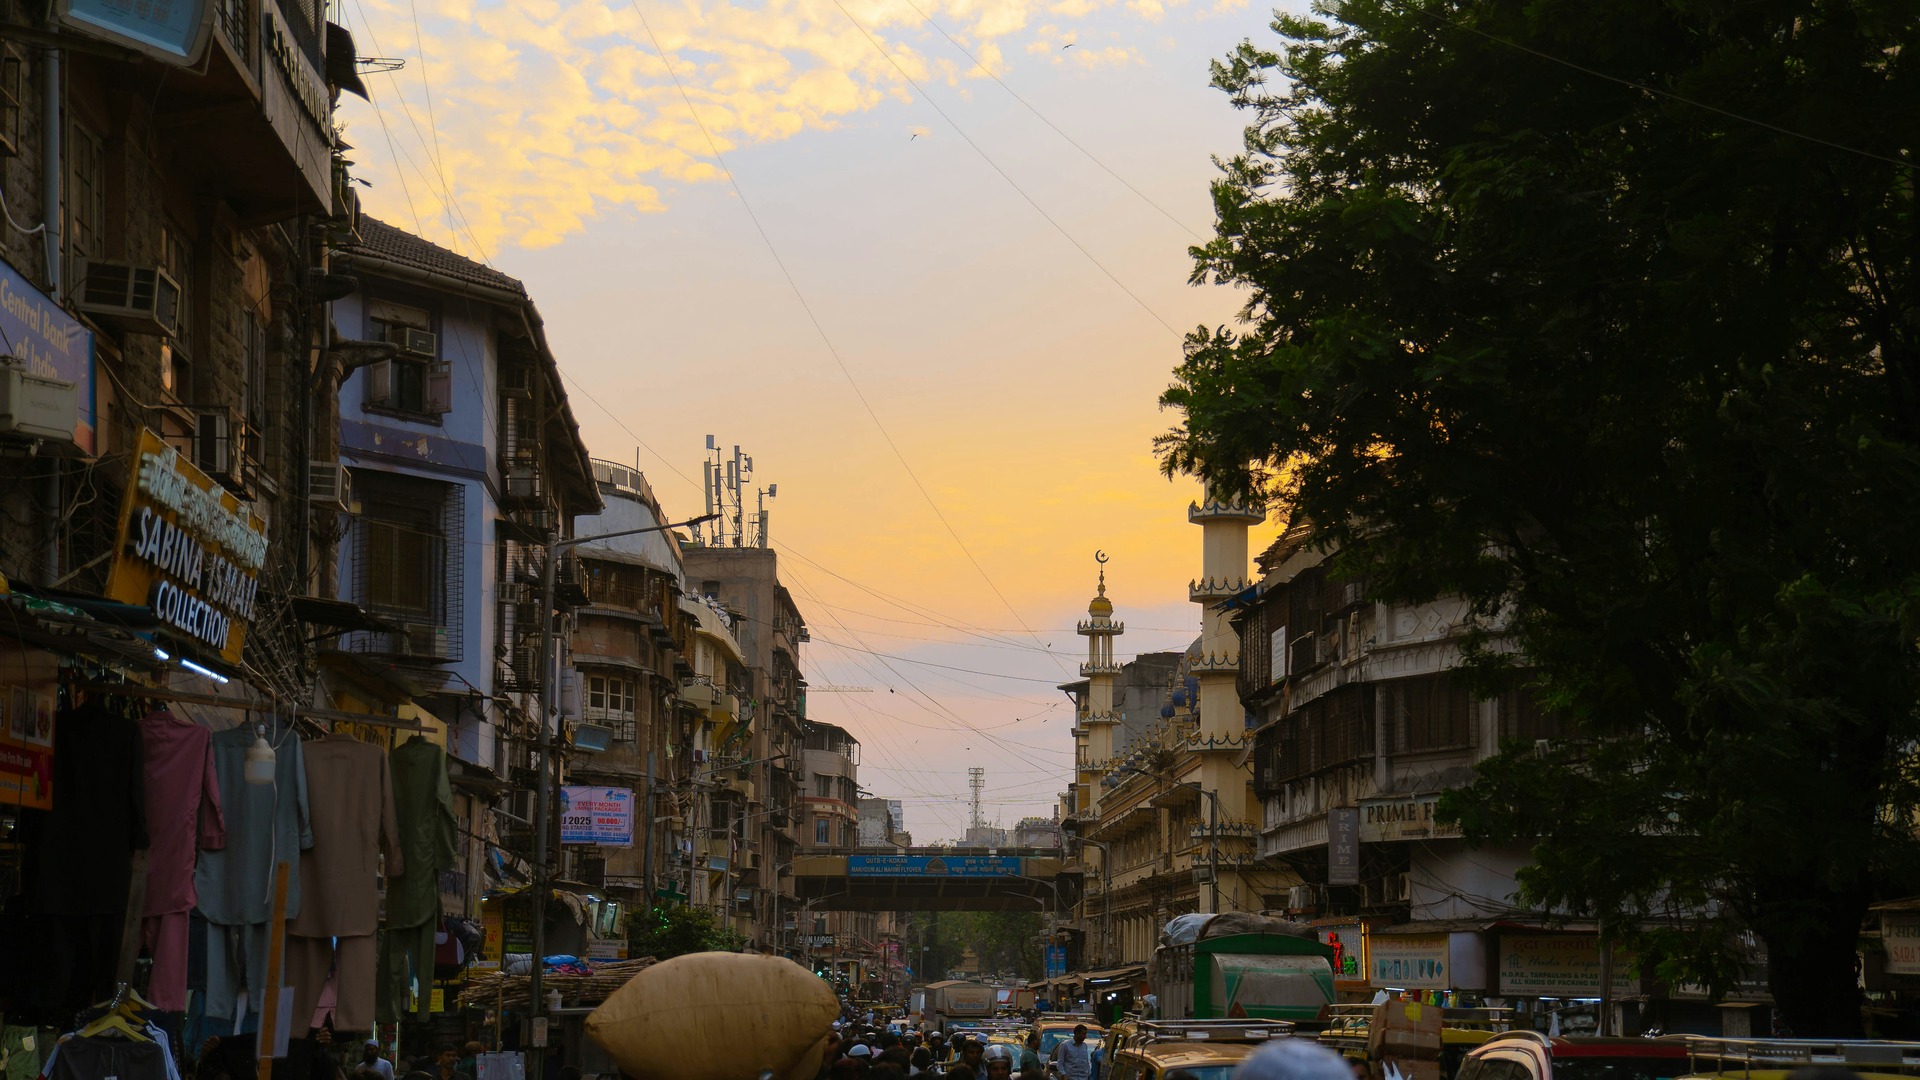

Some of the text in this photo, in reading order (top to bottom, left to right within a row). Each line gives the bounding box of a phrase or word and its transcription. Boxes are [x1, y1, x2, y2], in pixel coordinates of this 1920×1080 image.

[0, 278, 69, 356] Central Bank
[16, 335, 58, 379] of India
[136, 506, 202, 590] SABINA
[207, 553, 258, 622] ISMAIL
[156, 579, 230, 650] COLLECTION
[568, 816, 591, 825] 2025
[1367, 803, 1416, 823] PRIME
[1337, 812, 1352, 865] PRIME
[1894, 946, 1916, 962] SARA
